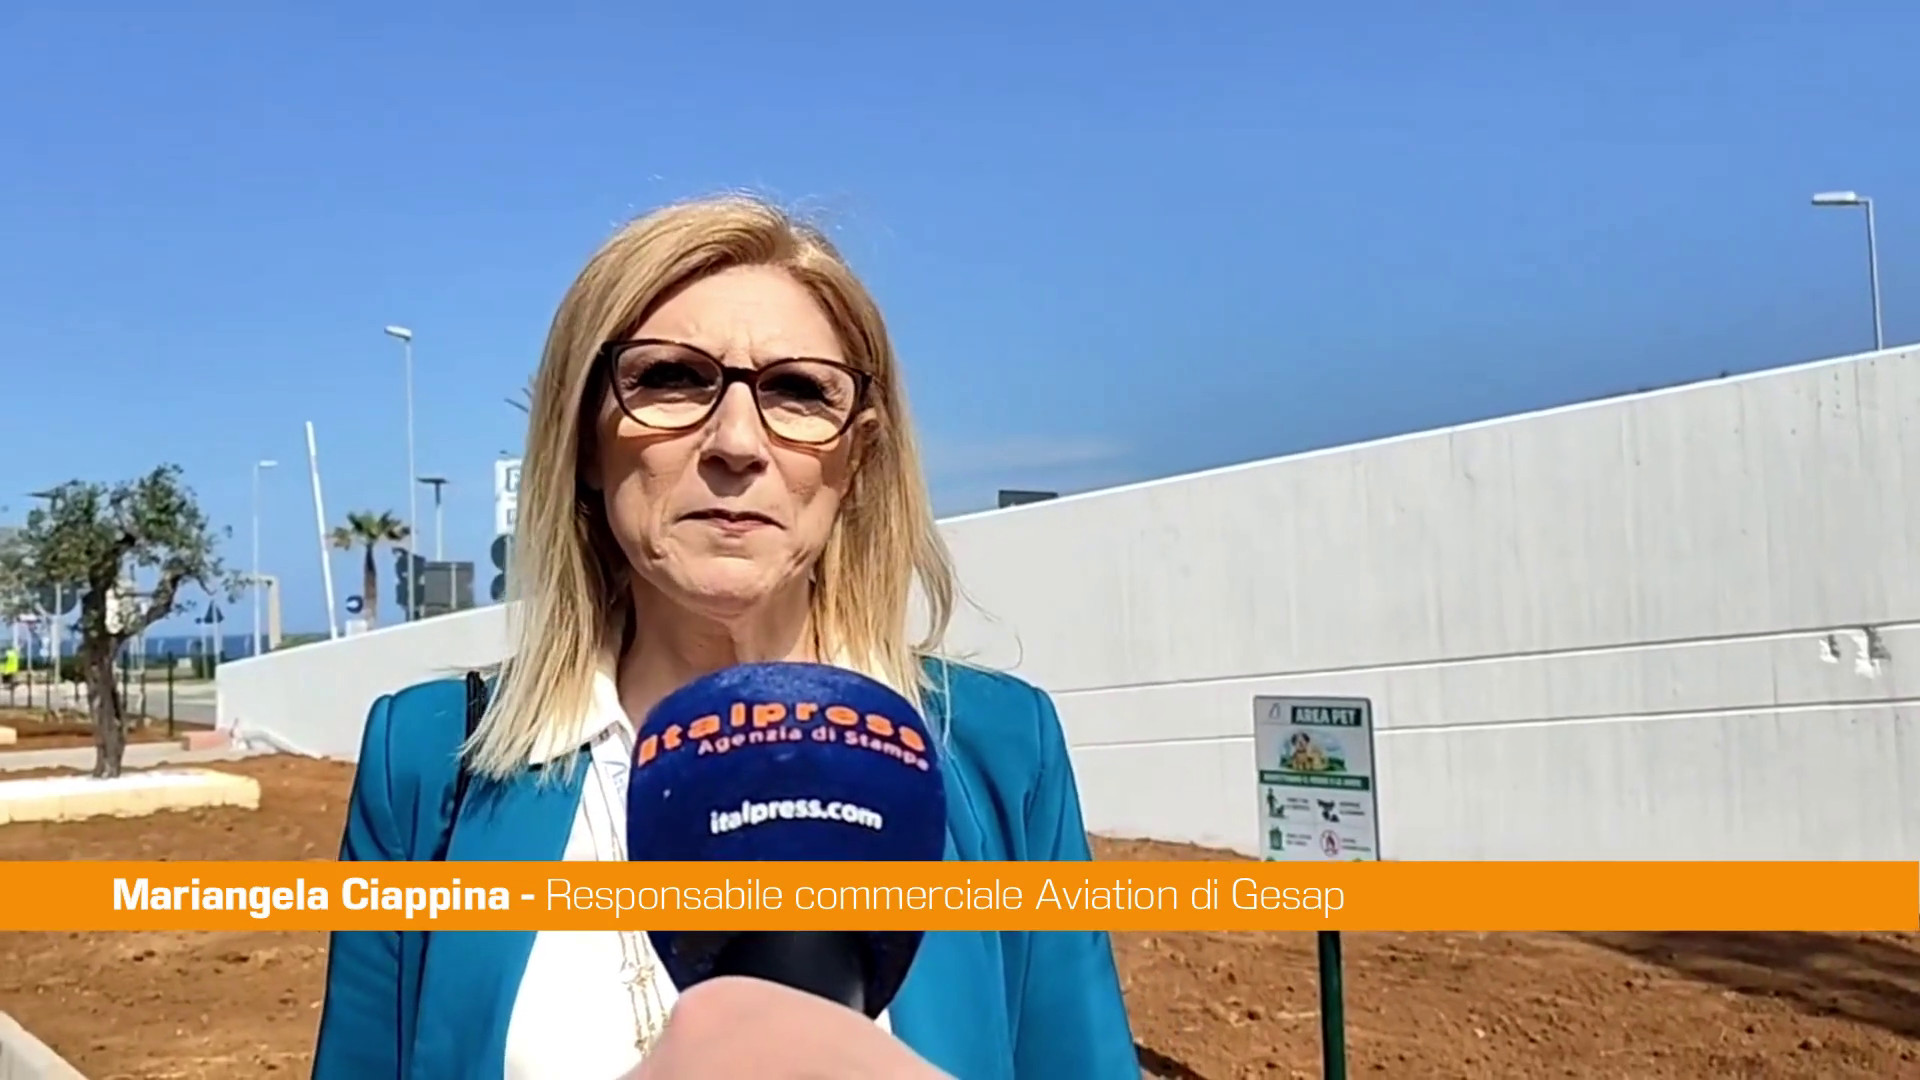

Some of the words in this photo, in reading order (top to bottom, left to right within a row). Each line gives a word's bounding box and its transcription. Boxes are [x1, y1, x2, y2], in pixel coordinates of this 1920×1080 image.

[1295, 707, 1330, 725] AREA
[1331, 708, 1356, 726] PET
[697, 726, 803, 756] Agenzia
[811, 726, 836, 742] di
[710, 799, 883, 835] italpress.com
